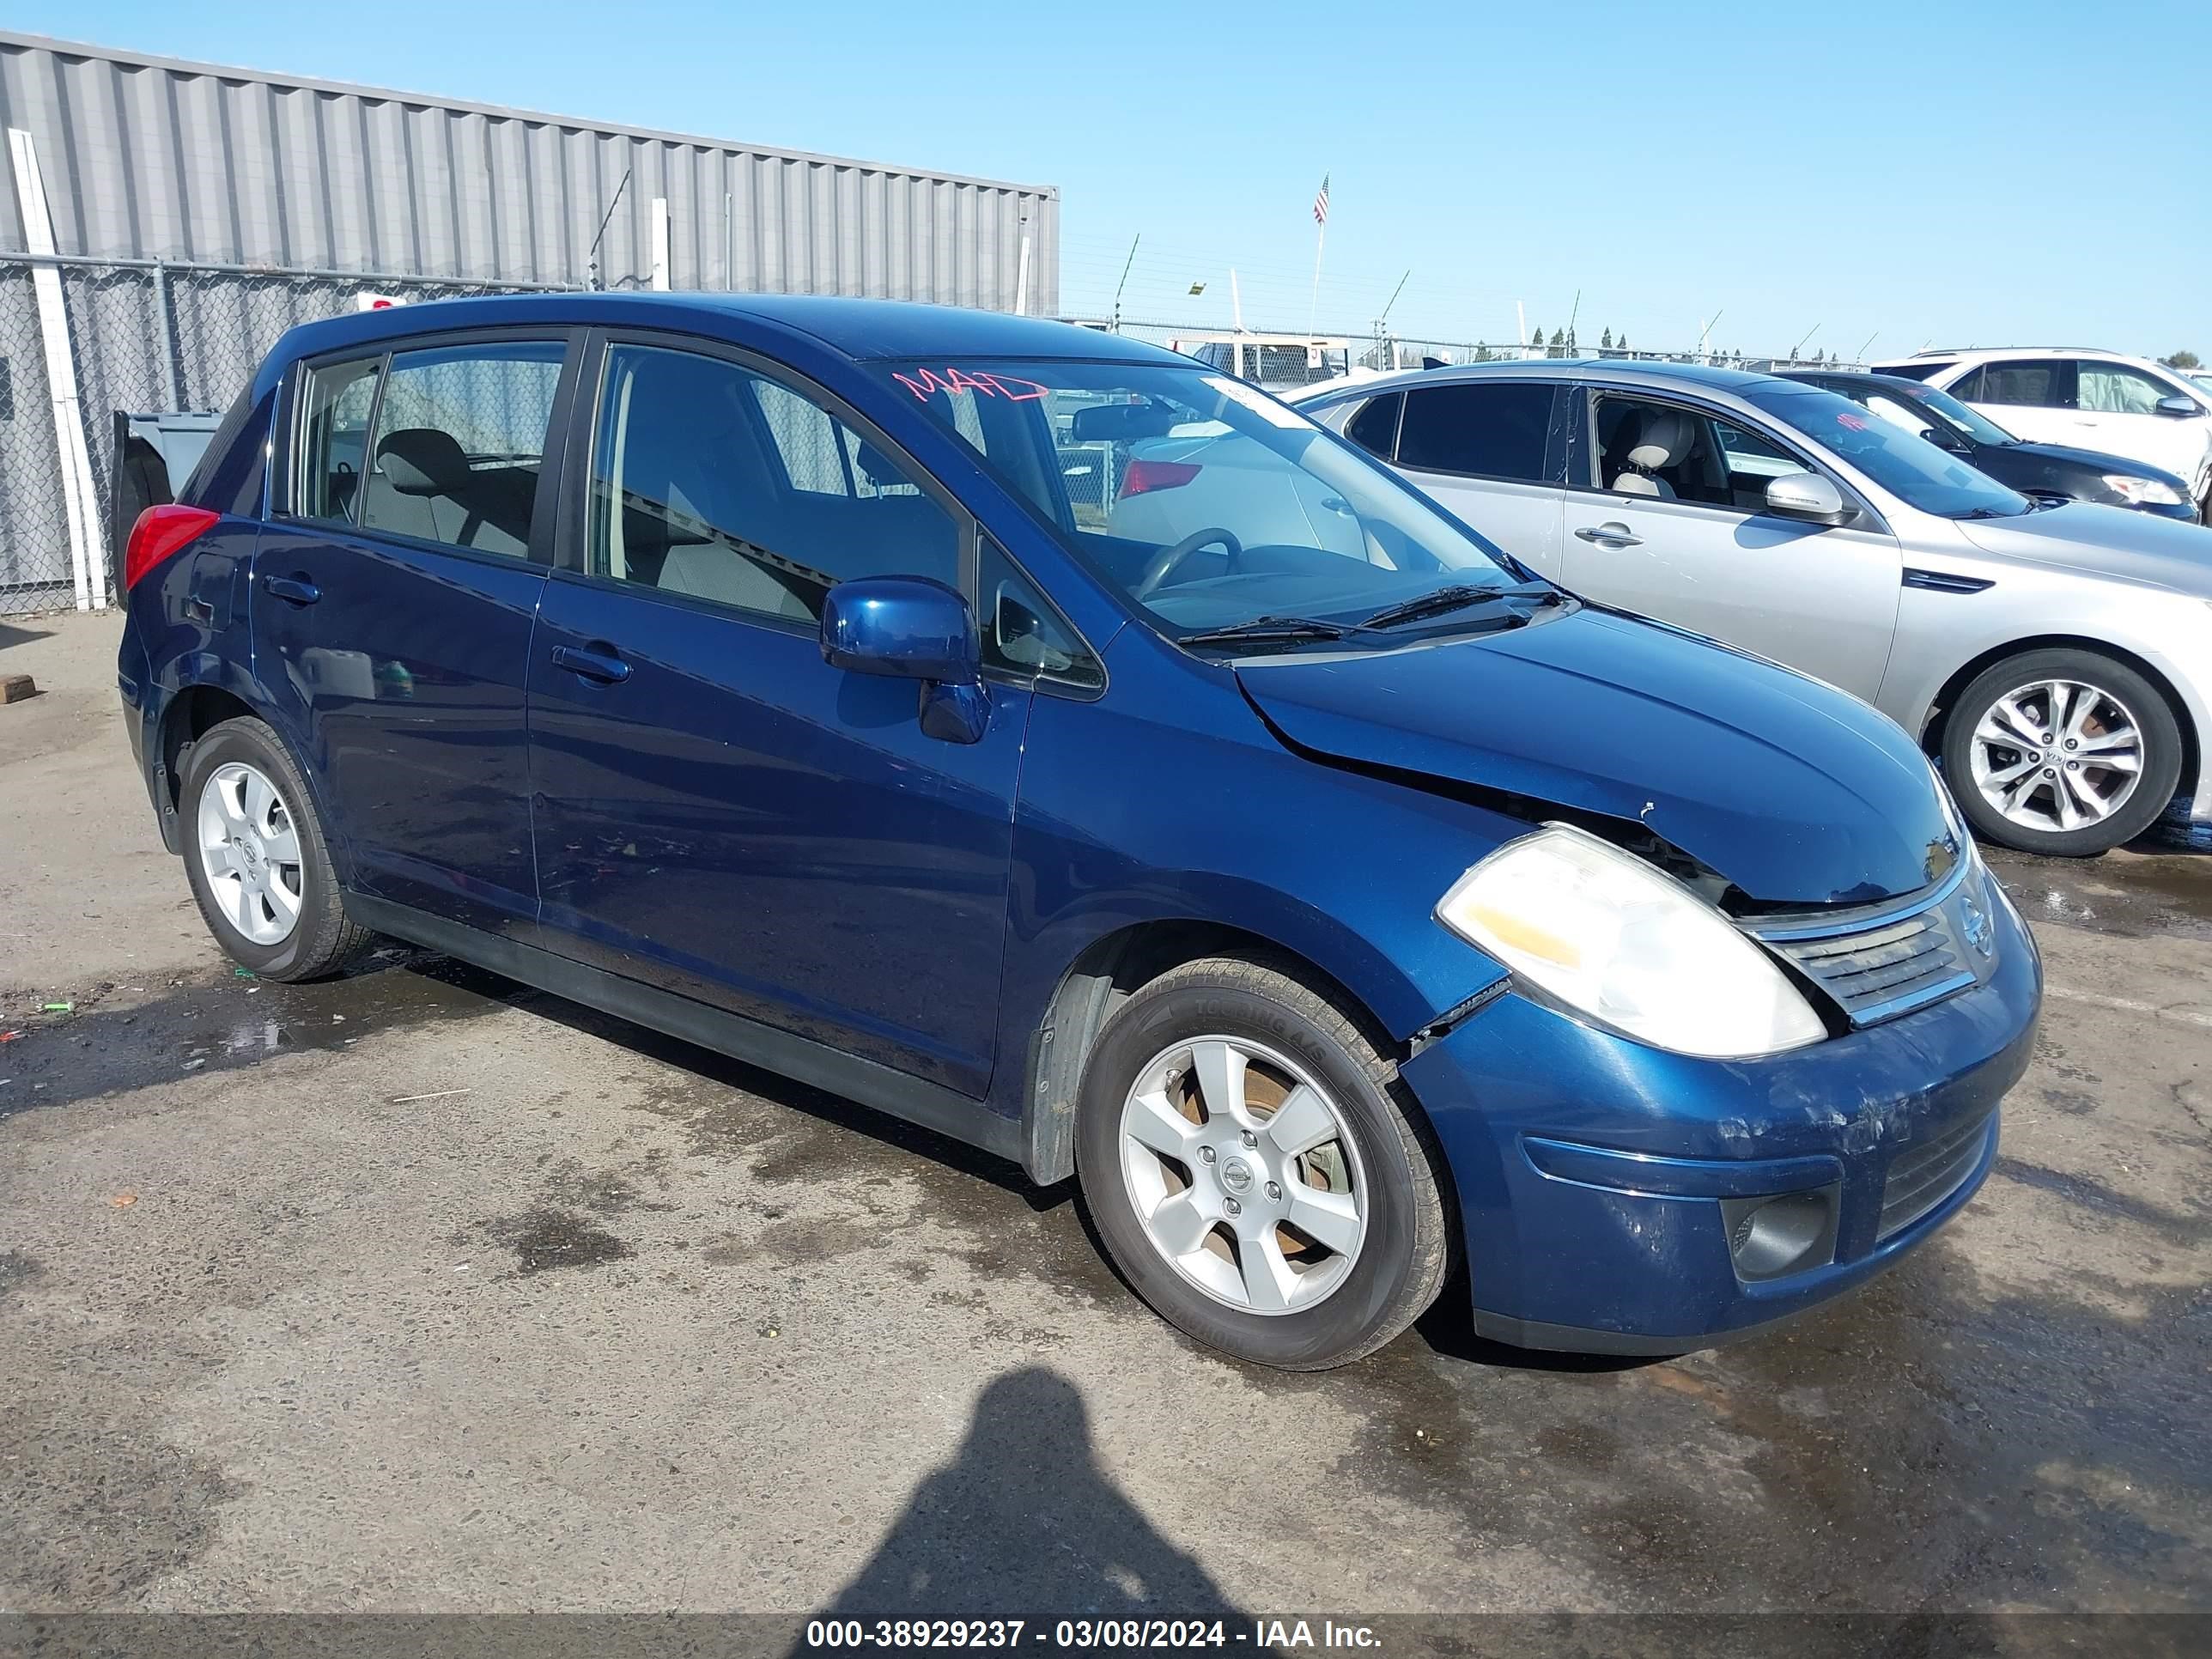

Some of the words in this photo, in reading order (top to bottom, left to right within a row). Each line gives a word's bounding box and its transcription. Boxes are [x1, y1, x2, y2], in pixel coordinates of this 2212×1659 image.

[890, 367, 1049, 403] MAD
[2046, 751, 2063, 763] KIA
[1194, 999, 1285, 1034] TOURING
